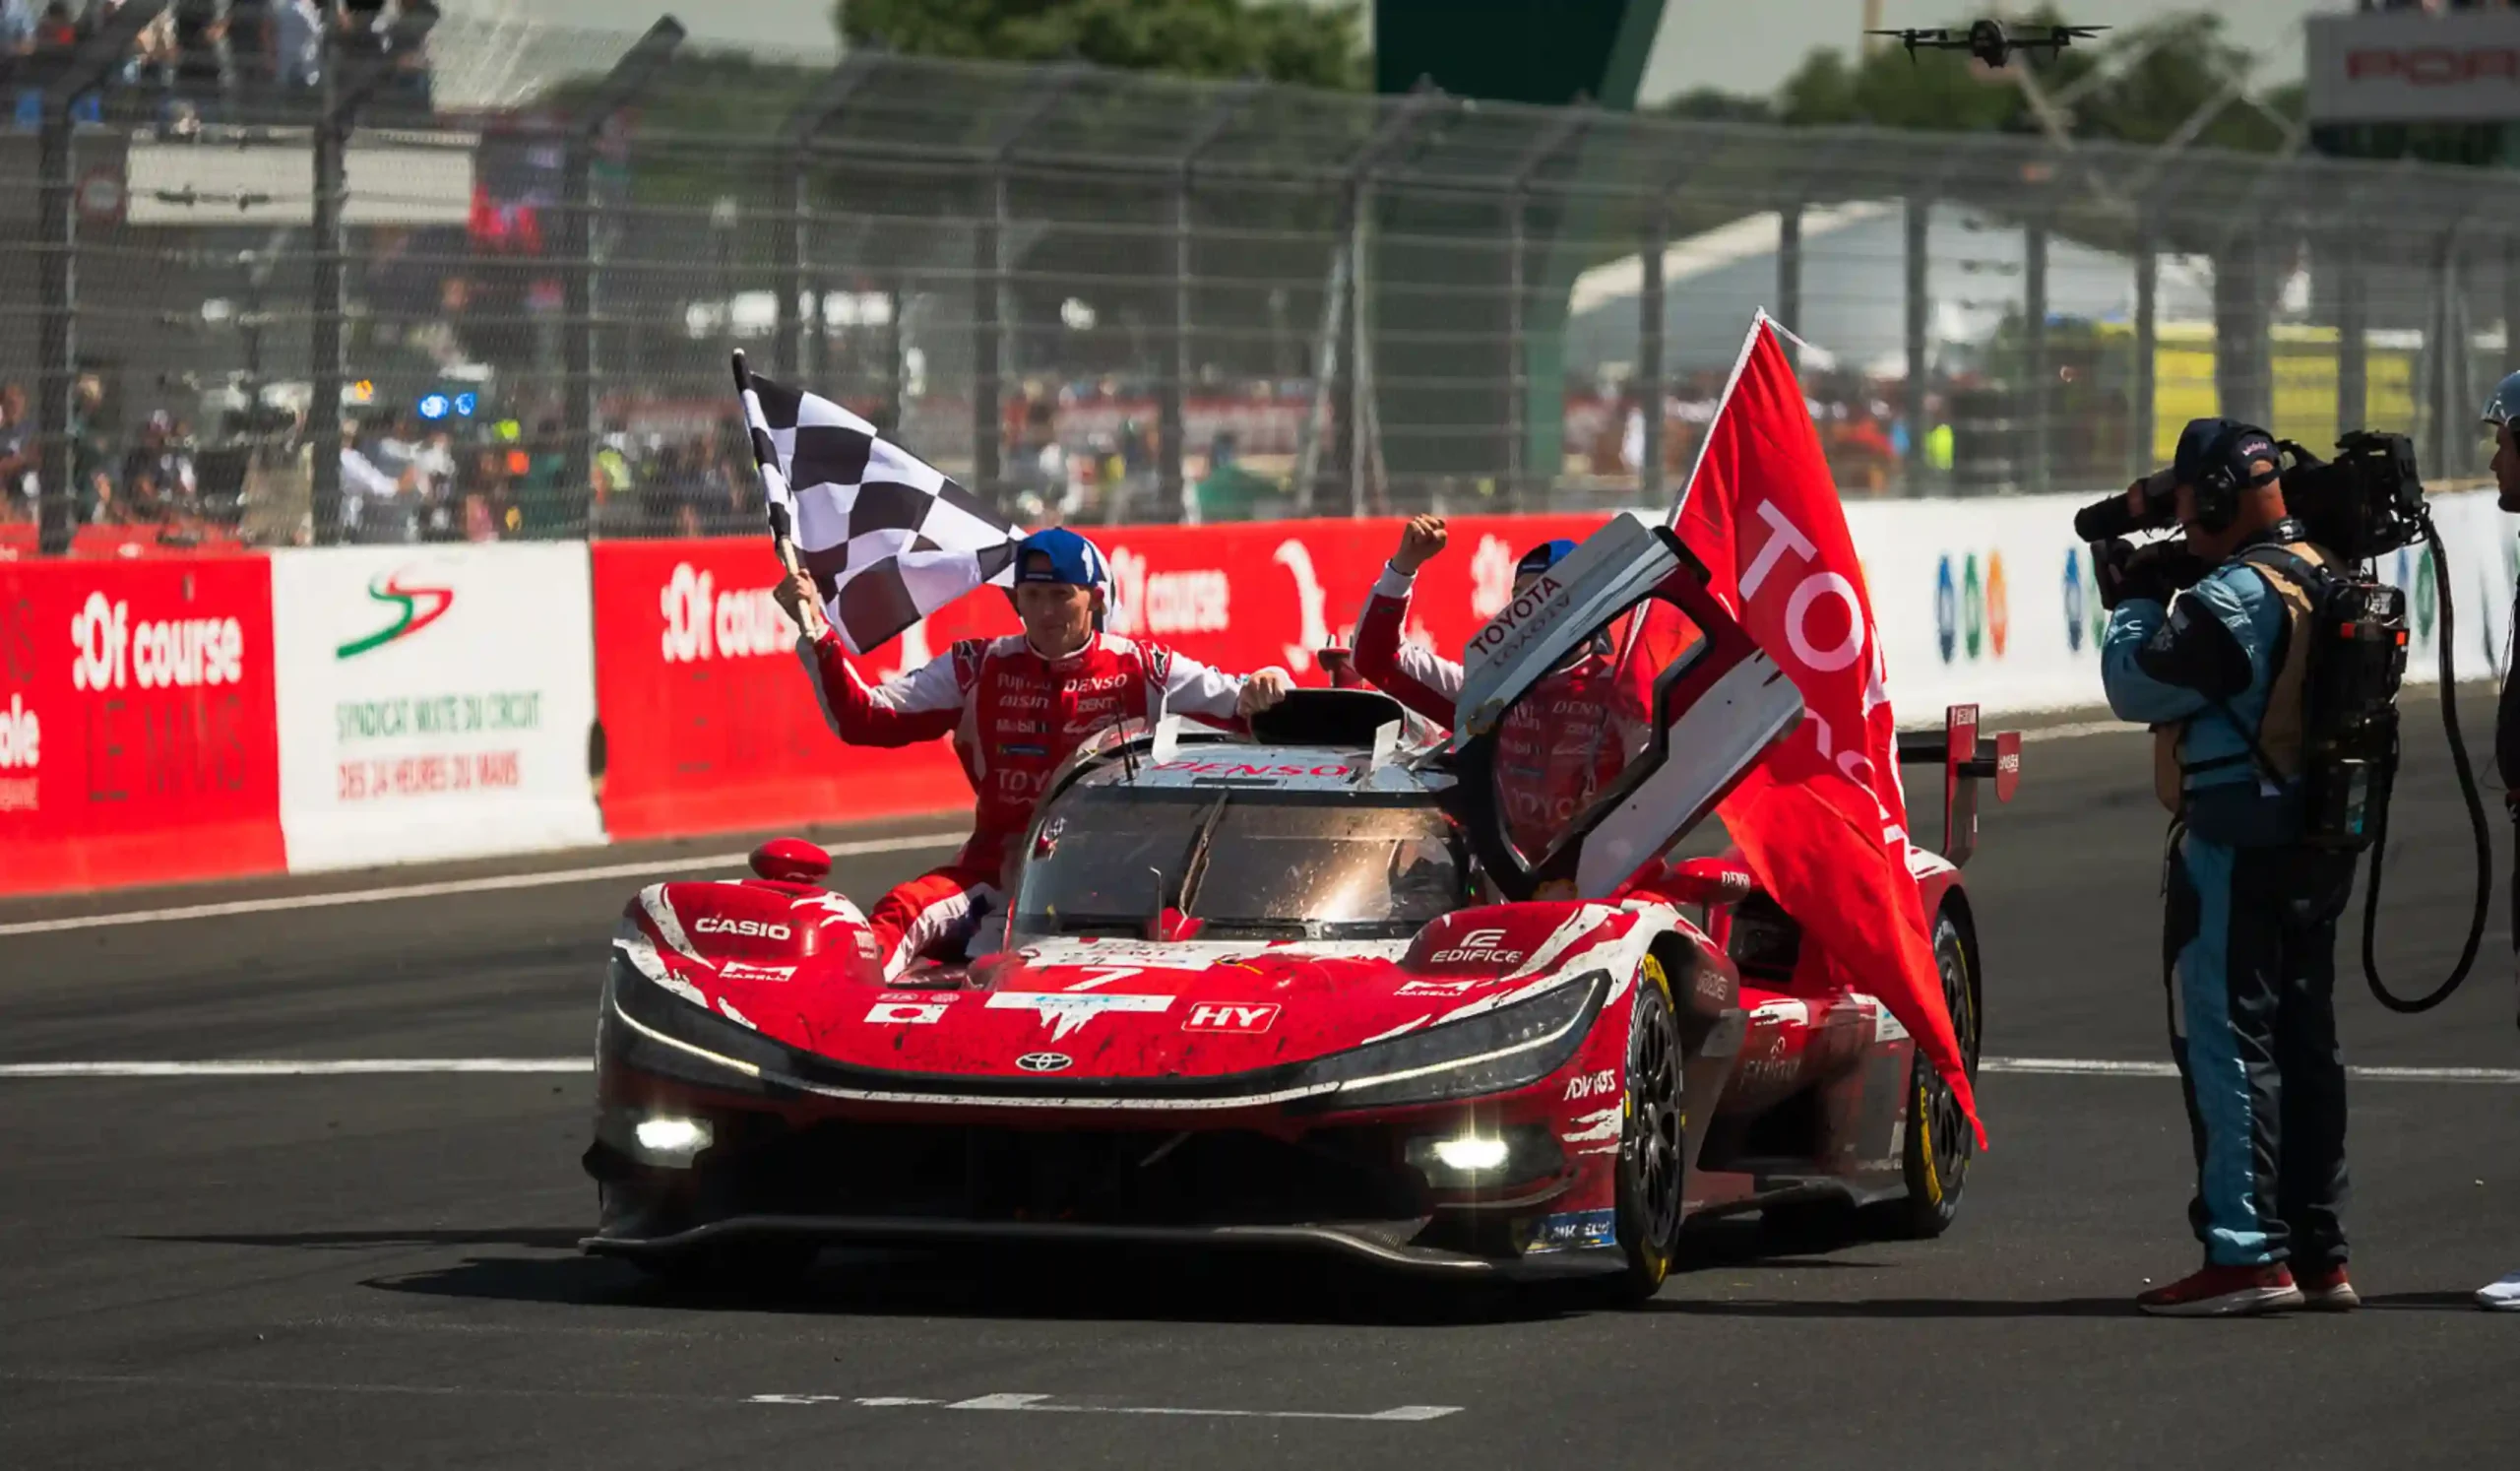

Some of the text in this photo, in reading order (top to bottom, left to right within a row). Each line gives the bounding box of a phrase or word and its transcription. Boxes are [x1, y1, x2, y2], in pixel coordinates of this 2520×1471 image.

[1147, 567, 1228, 635] course
[1470, 577, 1562, 656] TOYOTA
[133, 616, 243, 688] course
[1063, 673, 1128, 693] DENSO
[1153, 762, 1350, 777] DENSO
[695, 918, 791, 941] CASIO
[1430, 949, 1524, 964] EDIFICE
[1061, 966, 1145, 991] 7
[1393, 989, 1464, 997] MARELLI
[1190, 1006, 1272, 1027] HY
